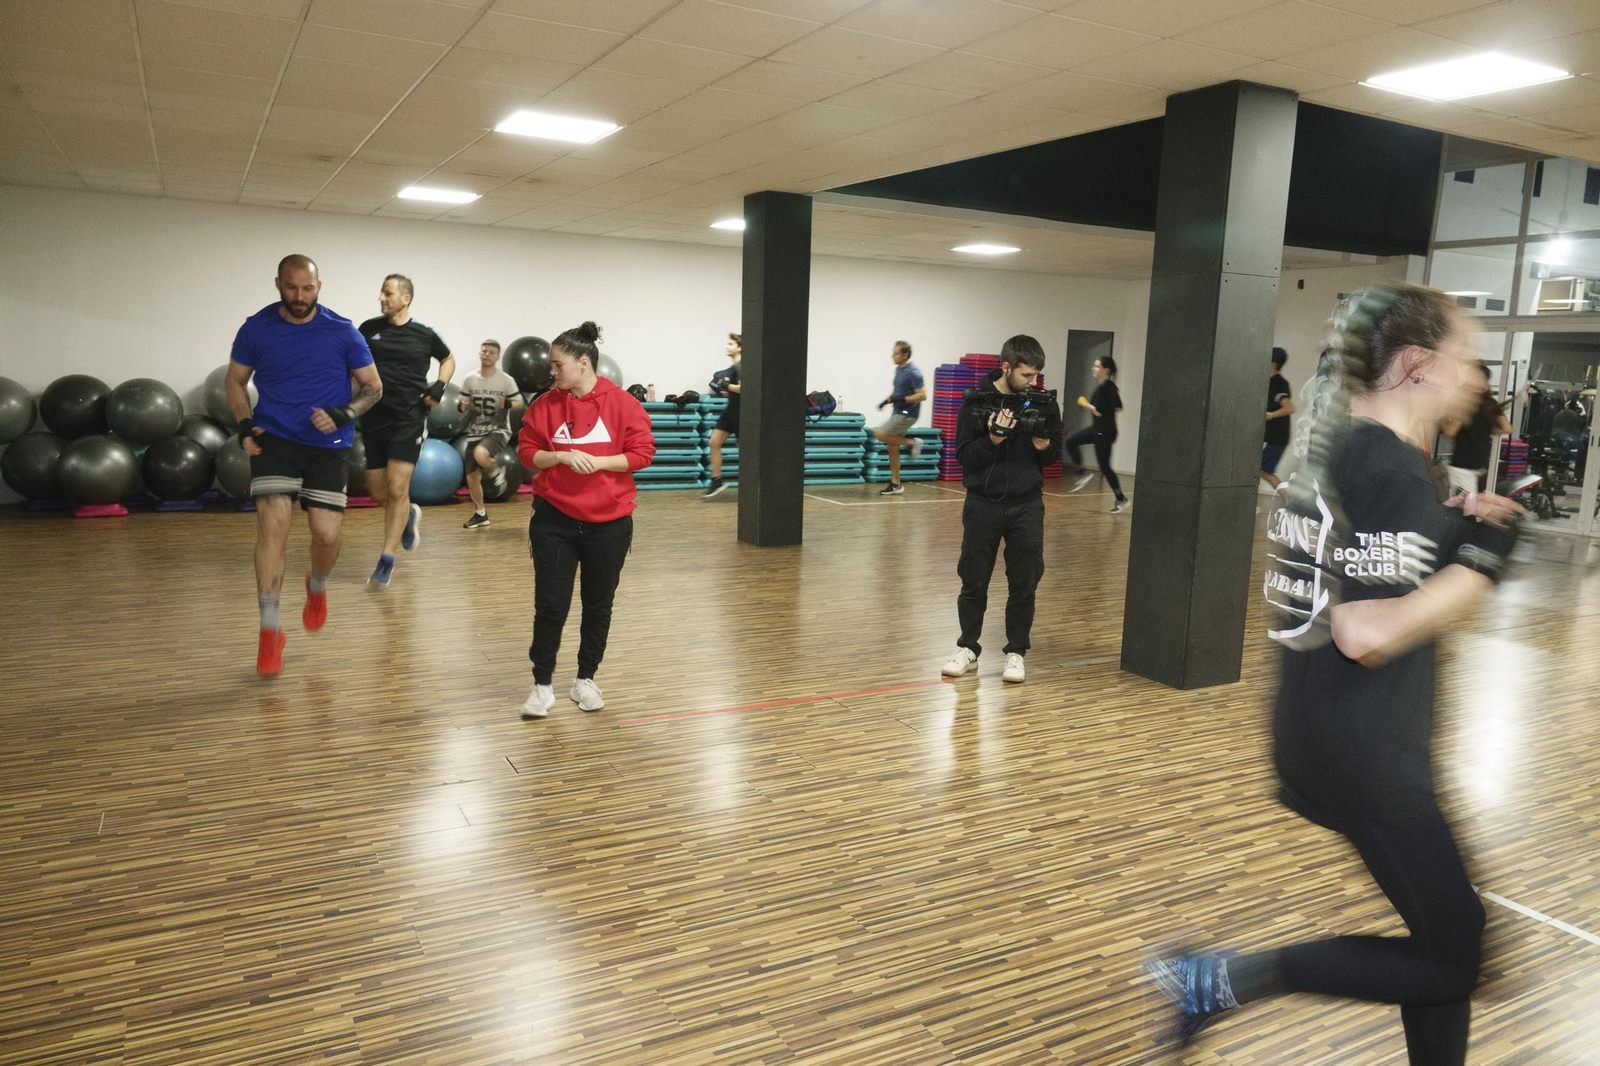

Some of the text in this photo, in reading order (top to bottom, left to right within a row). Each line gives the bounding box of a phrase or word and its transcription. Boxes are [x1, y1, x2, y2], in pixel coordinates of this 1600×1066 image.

[472, 396, 496, 417] 56
[1355, 531, 1394, 546] THE
[1333, 547, 1395, 561] BOXER
[1344, 562, 1396, 577] CLUB
